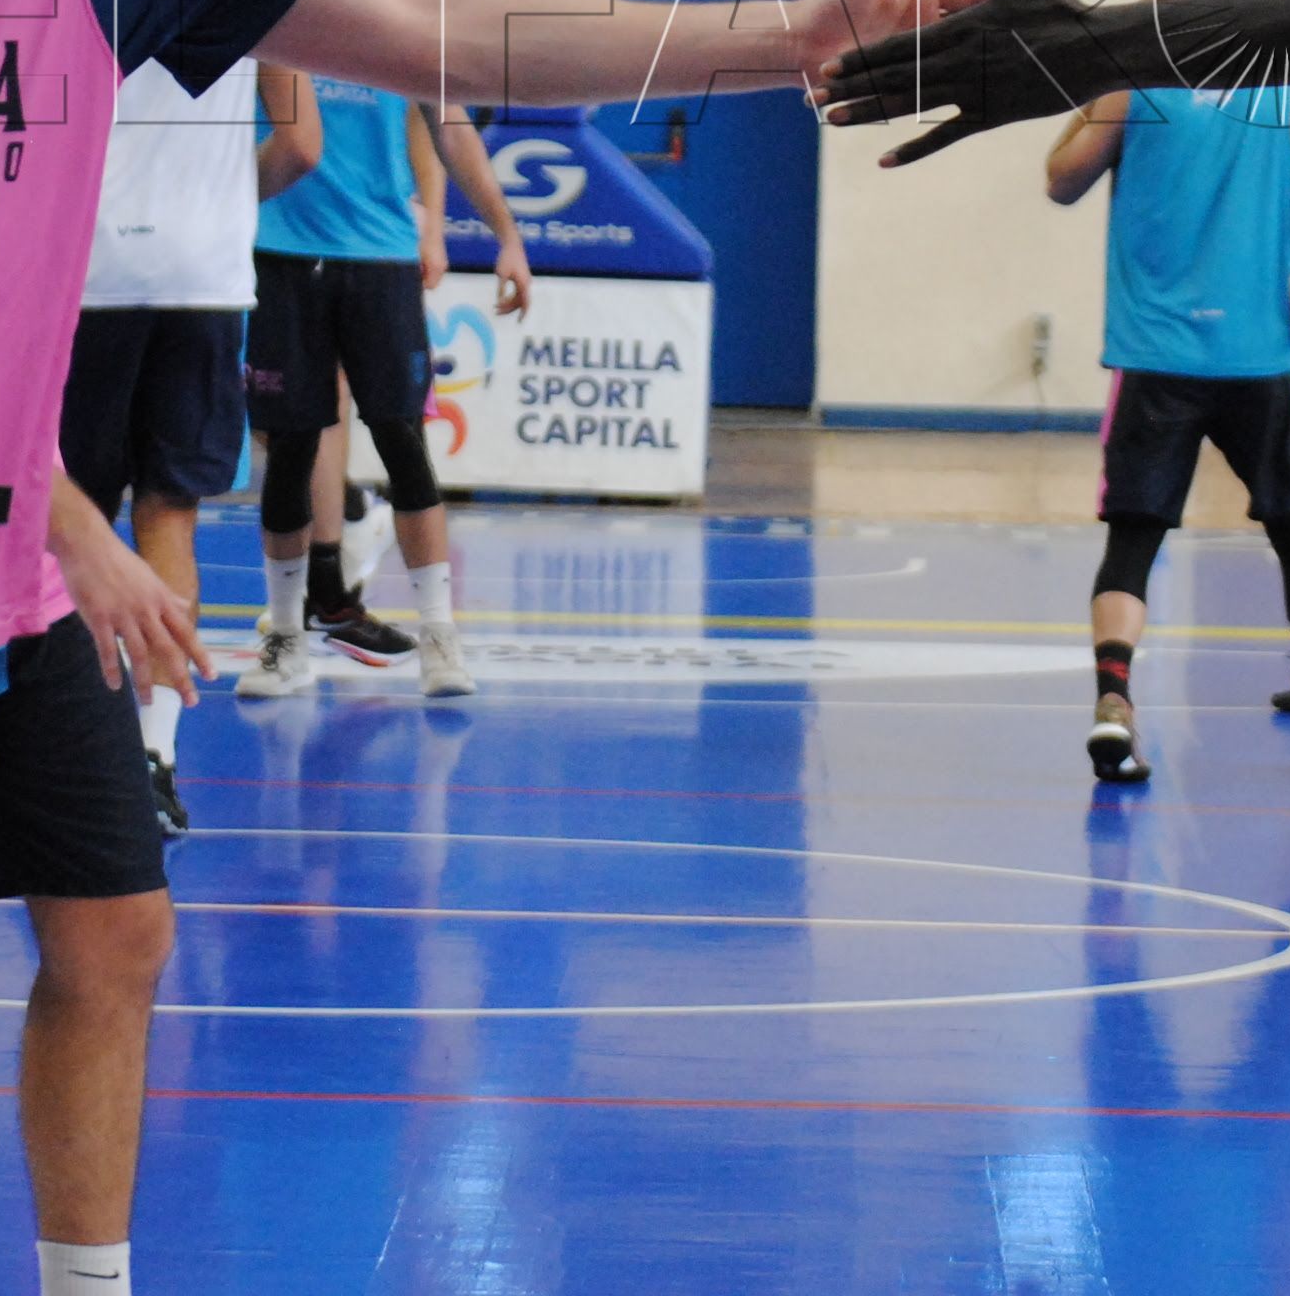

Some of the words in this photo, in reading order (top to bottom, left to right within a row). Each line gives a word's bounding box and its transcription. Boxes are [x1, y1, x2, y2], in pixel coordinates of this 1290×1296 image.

[546, 220, 633, 246] Sports
[519, 336, 683, 373] MELILLA
[518, 375, 651, 409] SPORT
[516, 413, 679, 449] CAPITAL
